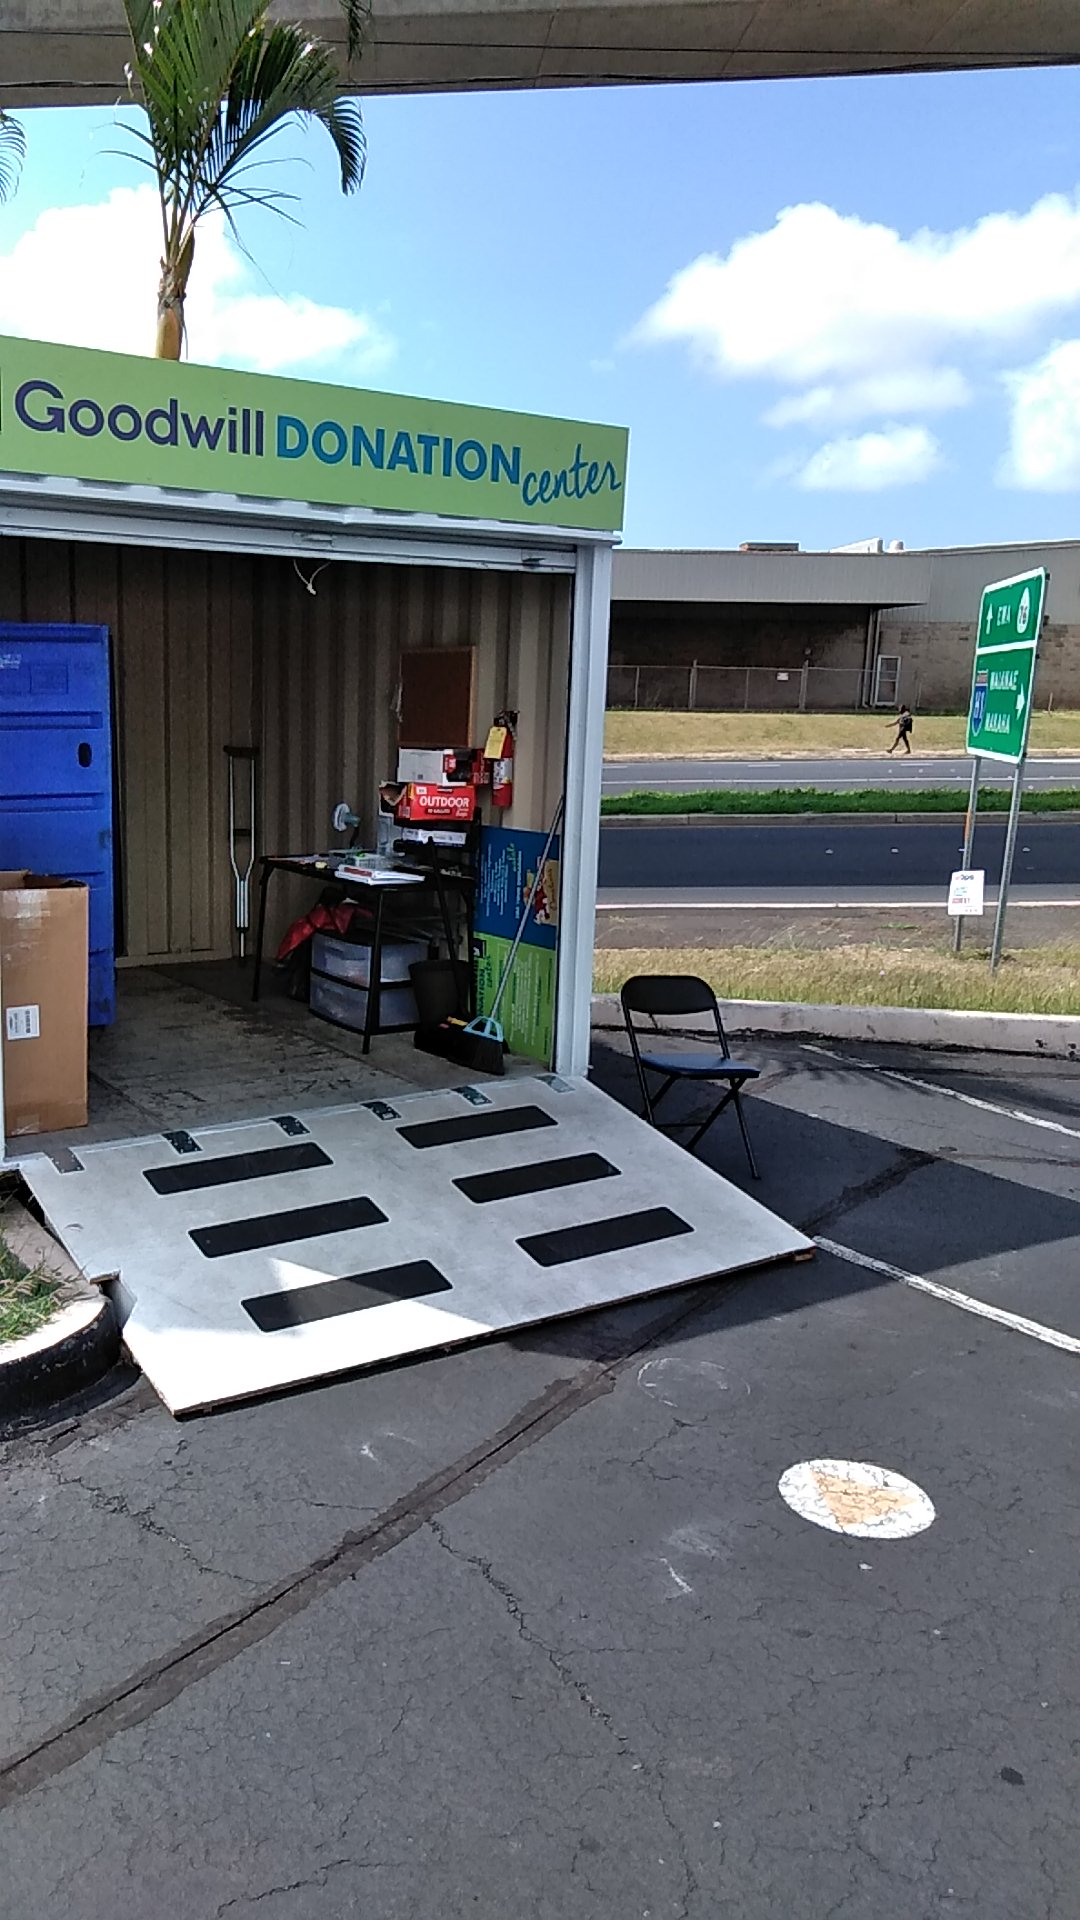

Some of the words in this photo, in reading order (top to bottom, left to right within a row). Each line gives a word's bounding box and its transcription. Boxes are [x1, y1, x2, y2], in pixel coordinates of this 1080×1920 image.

[14, 379, 264, 457] Goodwill
[276, 414, 521, 485] DONATION
[522, 443, 622, 506] center
[419, 795, 470, 808] OUTDOOR
